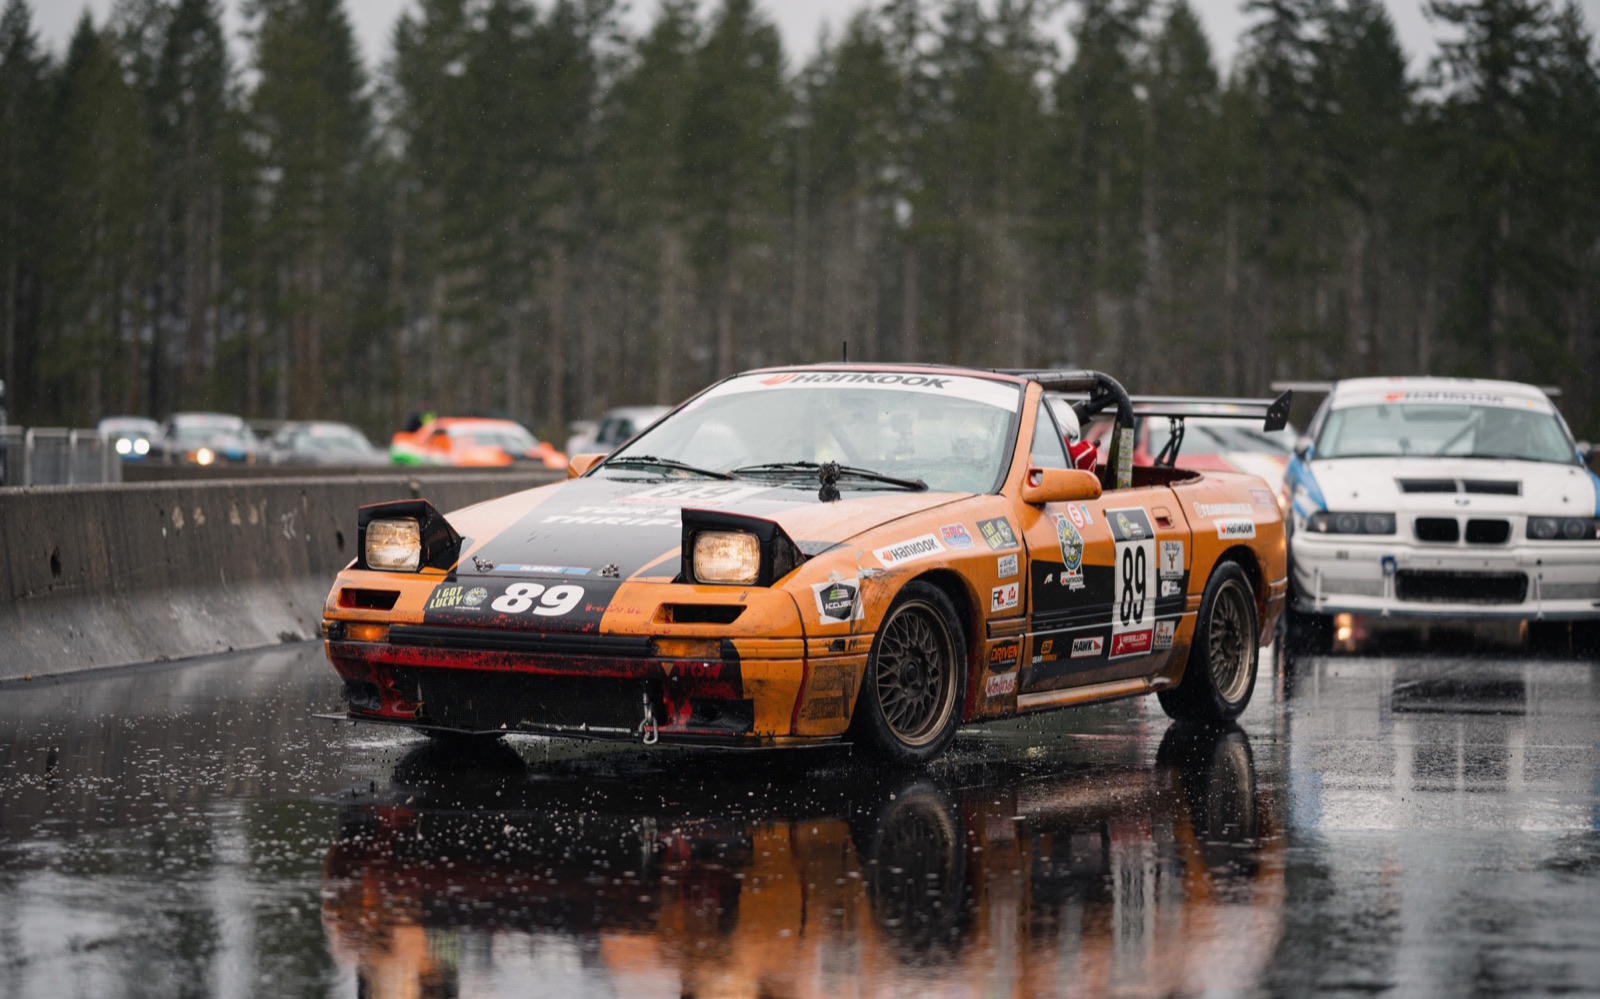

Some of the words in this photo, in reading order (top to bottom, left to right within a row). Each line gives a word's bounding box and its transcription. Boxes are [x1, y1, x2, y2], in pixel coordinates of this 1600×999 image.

[540, 515, 682, 528] THRIF
[442, 585, 464, 598] GOT
[1120, 545, 1146, 627] 89
[429, 595, 463, 610] LUCKY
[491, 582, 585, 616] 89
[991, 644, 1018, 664] DRIVEN
[1073, 640, 1093, 652] HAWK
[674, 660, 722, 679] TOW
